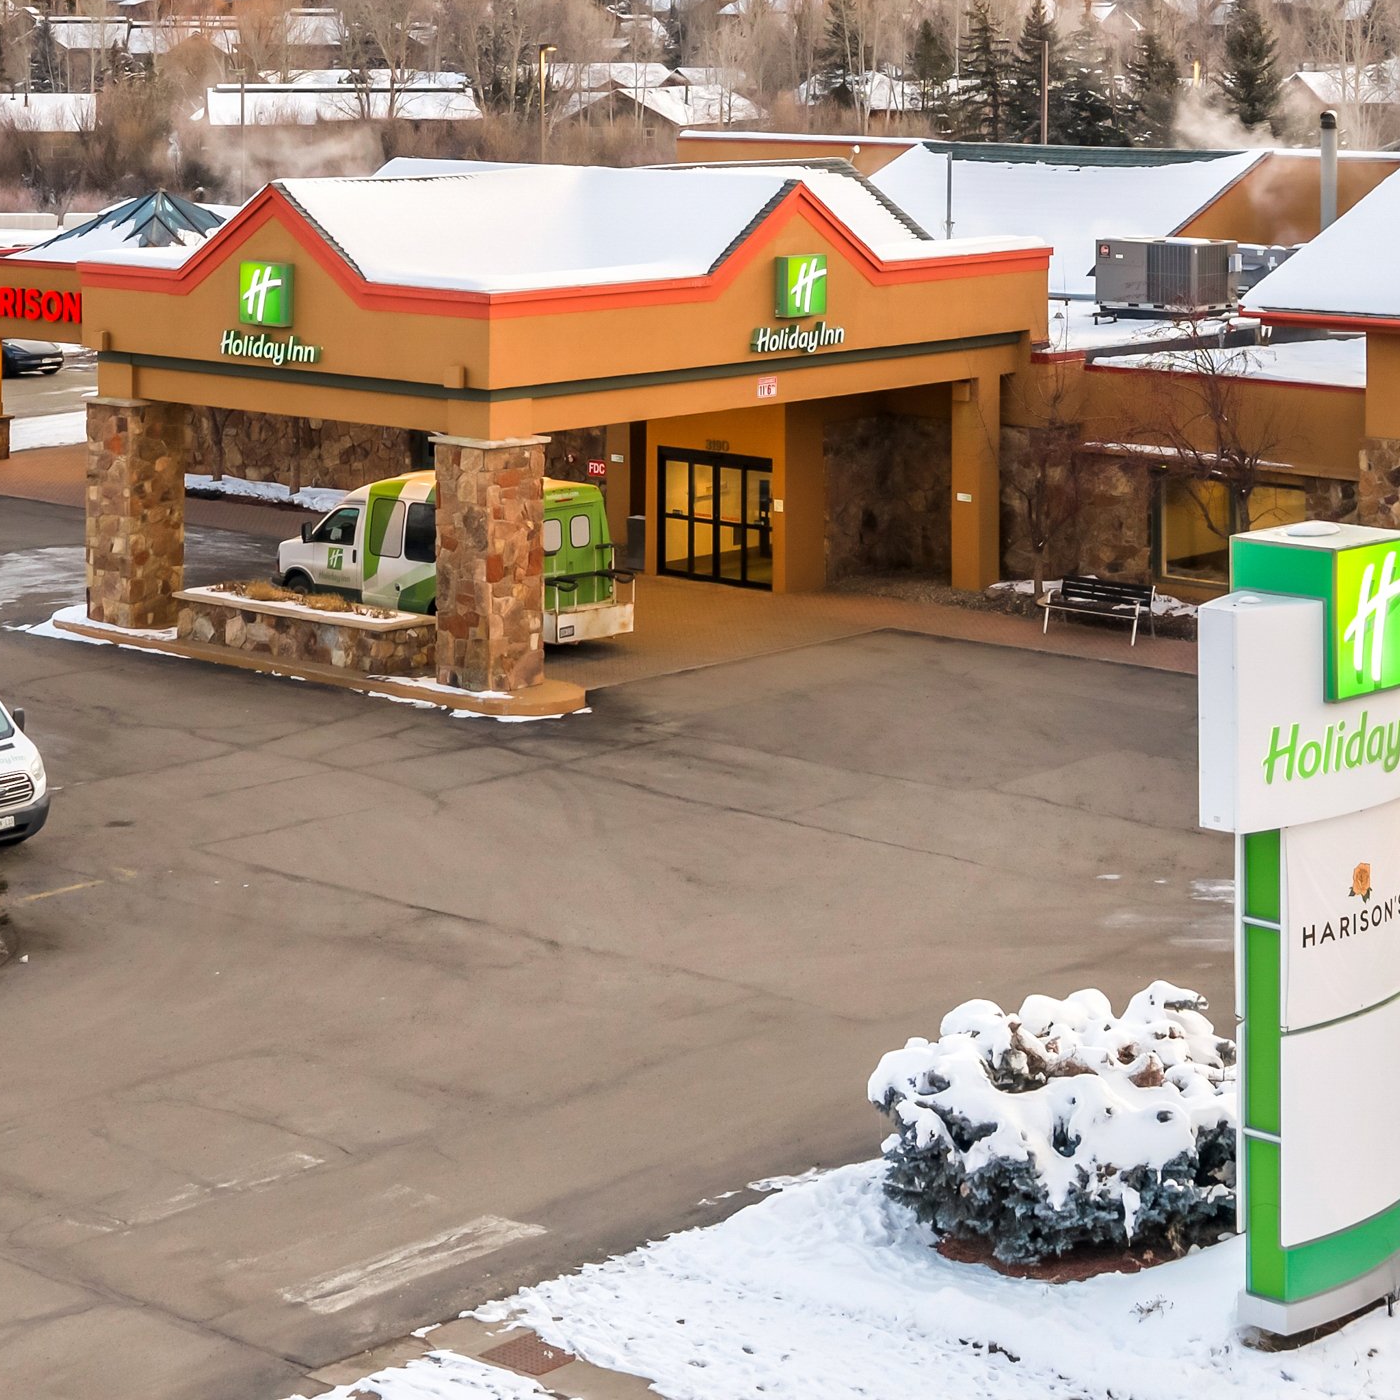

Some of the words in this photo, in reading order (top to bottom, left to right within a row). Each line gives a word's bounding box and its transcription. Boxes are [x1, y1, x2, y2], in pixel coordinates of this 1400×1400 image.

[220, 330, 285, 366] Holiday
[287, 335, 315, 363] Inn
[756, 324, 818, 353] Holiday
[819, 321, 845, 346] Inn
[588, 462, 605, 475] FDC
